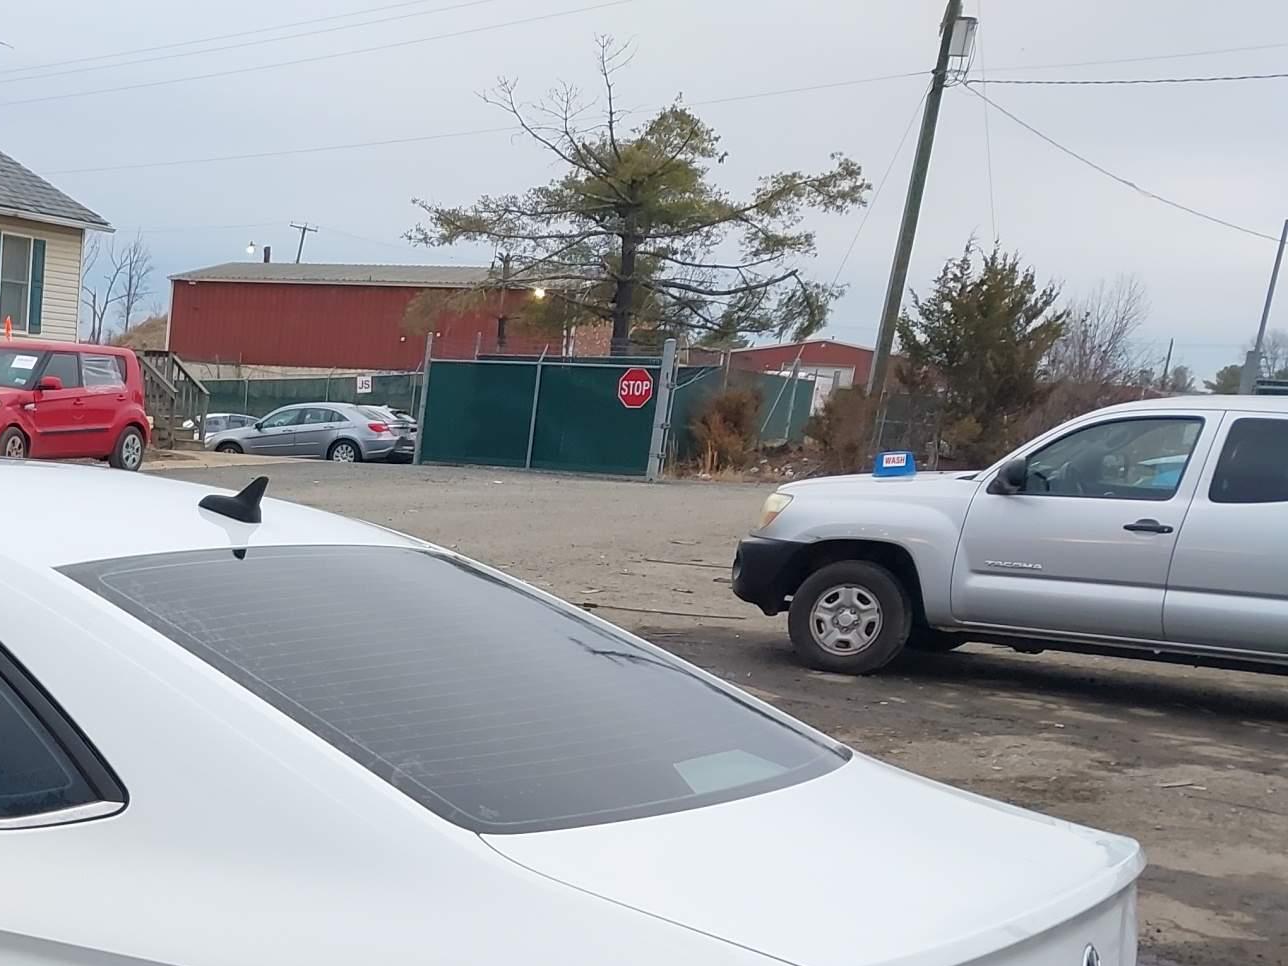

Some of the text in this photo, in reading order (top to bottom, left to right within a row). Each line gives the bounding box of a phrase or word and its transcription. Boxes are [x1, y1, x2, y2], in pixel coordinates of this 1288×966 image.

[621, 380, 650, 396] STOP
[885, 456, 905, 465] WASH
[984, 560, 1043, 569] TACOMA
